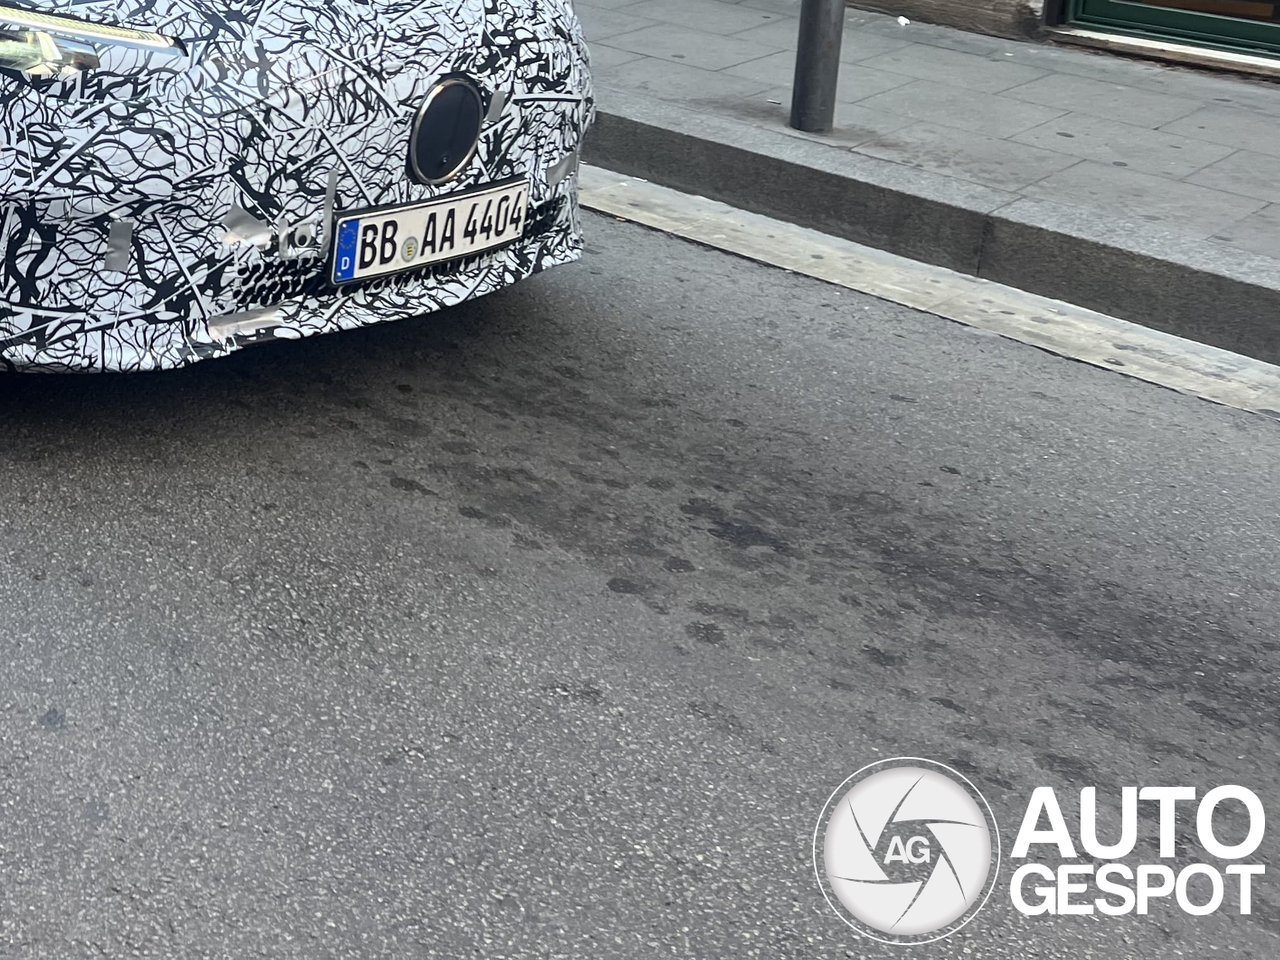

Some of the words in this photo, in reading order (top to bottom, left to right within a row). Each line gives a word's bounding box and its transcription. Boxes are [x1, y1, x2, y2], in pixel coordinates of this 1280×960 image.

[341, 256, 350, 271] D
[358, 219, 399, 270] BB
[419, 207, 456, 257] AA
[463, 191, 523, 245] 4404
